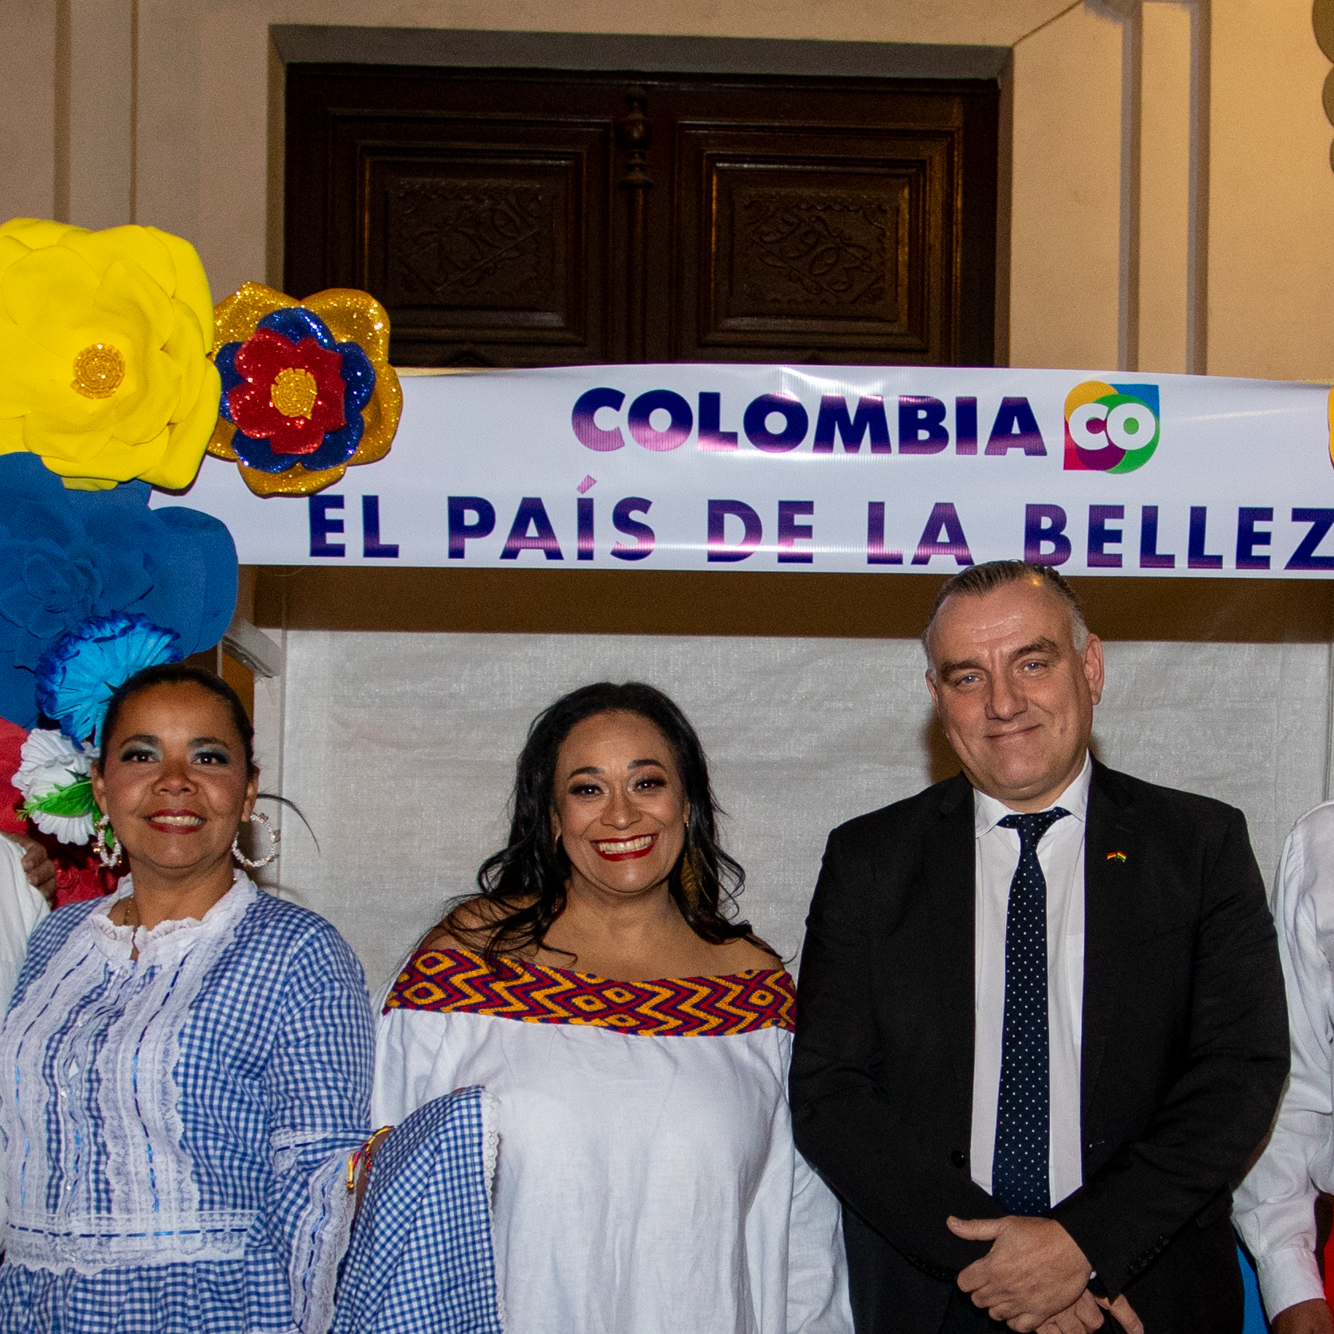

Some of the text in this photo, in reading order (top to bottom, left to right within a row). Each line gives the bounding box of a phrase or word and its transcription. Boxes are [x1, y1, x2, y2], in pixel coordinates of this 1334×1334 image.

[572, 387, 1156, 456] COLOMBIA CO
[308, 494, 400, 558] EL
[447, 474, 657, 561] PAÍS
[707, 499, 815, 564] DE
[867, 501, 975, 567] LA
